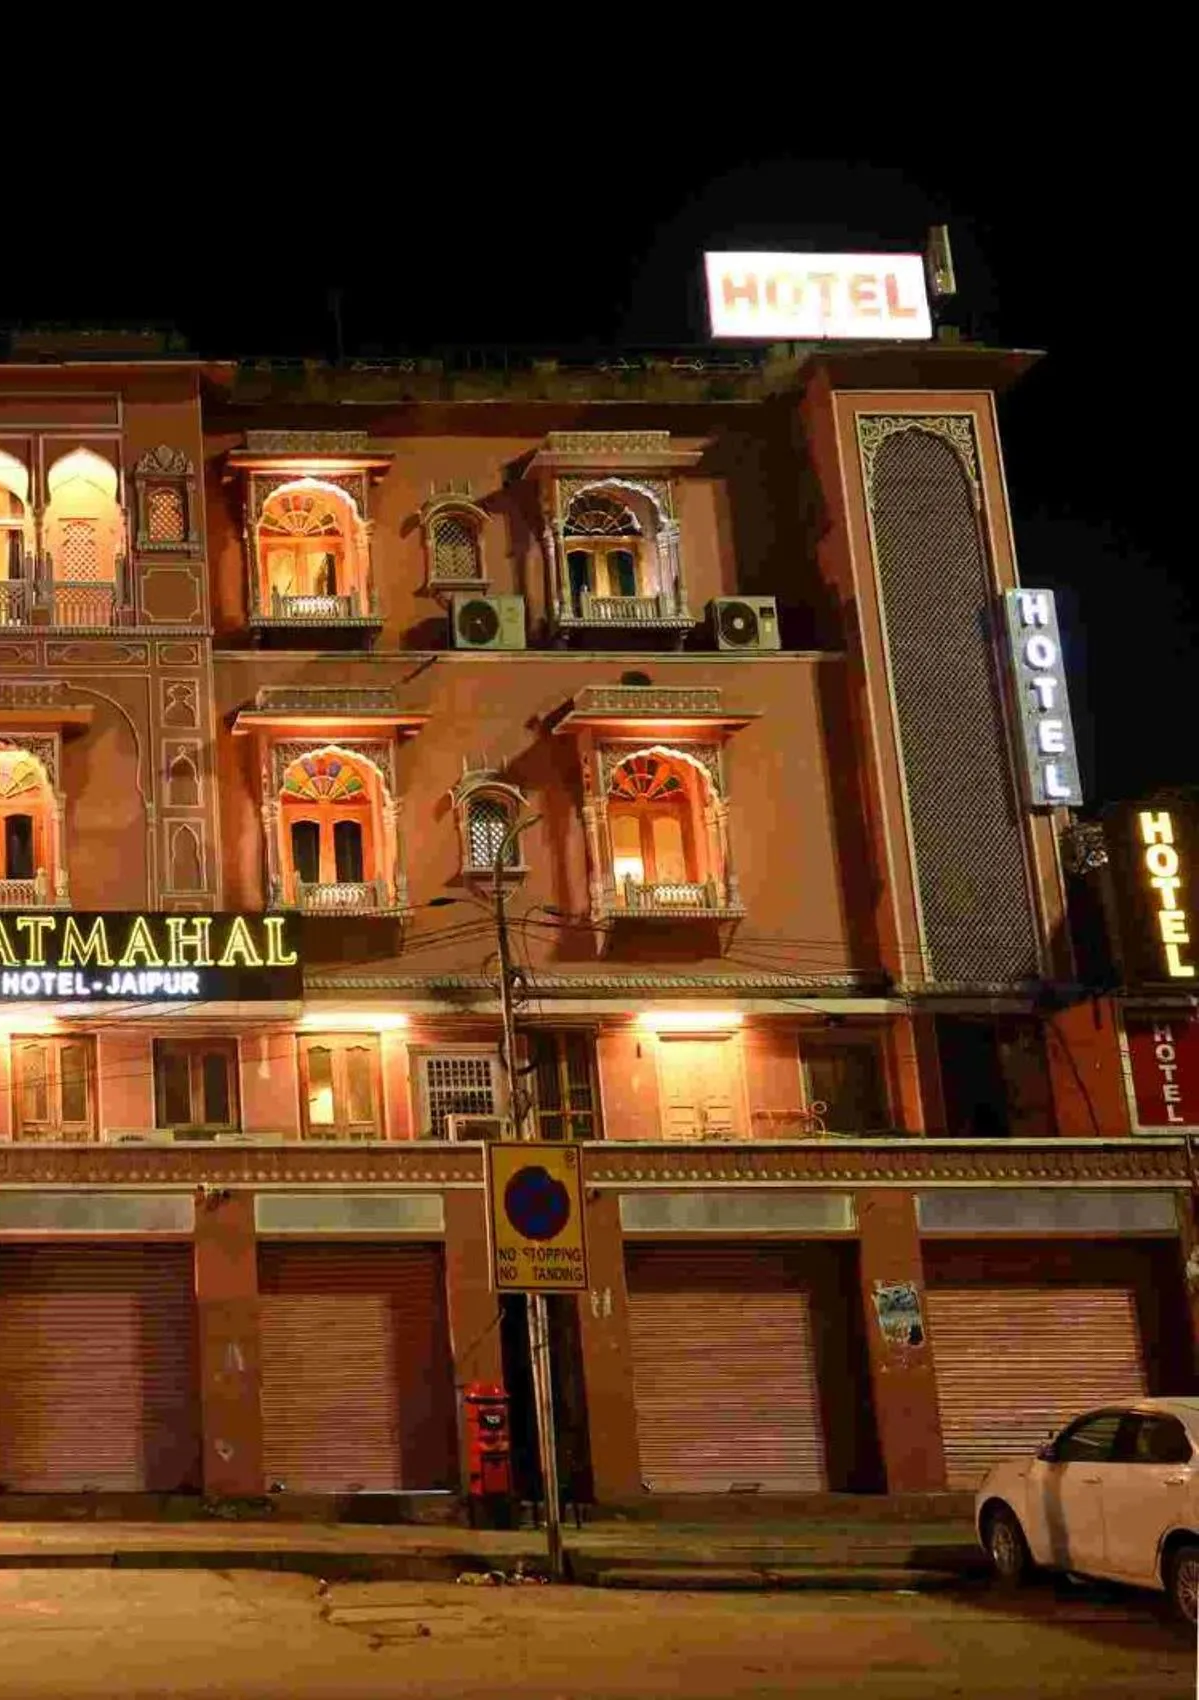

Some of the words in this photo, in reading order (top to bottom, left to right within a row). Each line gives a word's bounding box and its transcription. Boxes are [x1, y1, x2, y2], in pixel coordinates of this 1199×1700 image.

[722, 271, 917, 318] HOTEL
[1020, 594, 1071, 797] HOTEL
[1139, 811, 1195, 978] HOTEL
[1154, 1023, 1184, 1122] HOTEL
[497, 1247, 517, 1262] NO
[500, 1266, 518, 1281] NO
